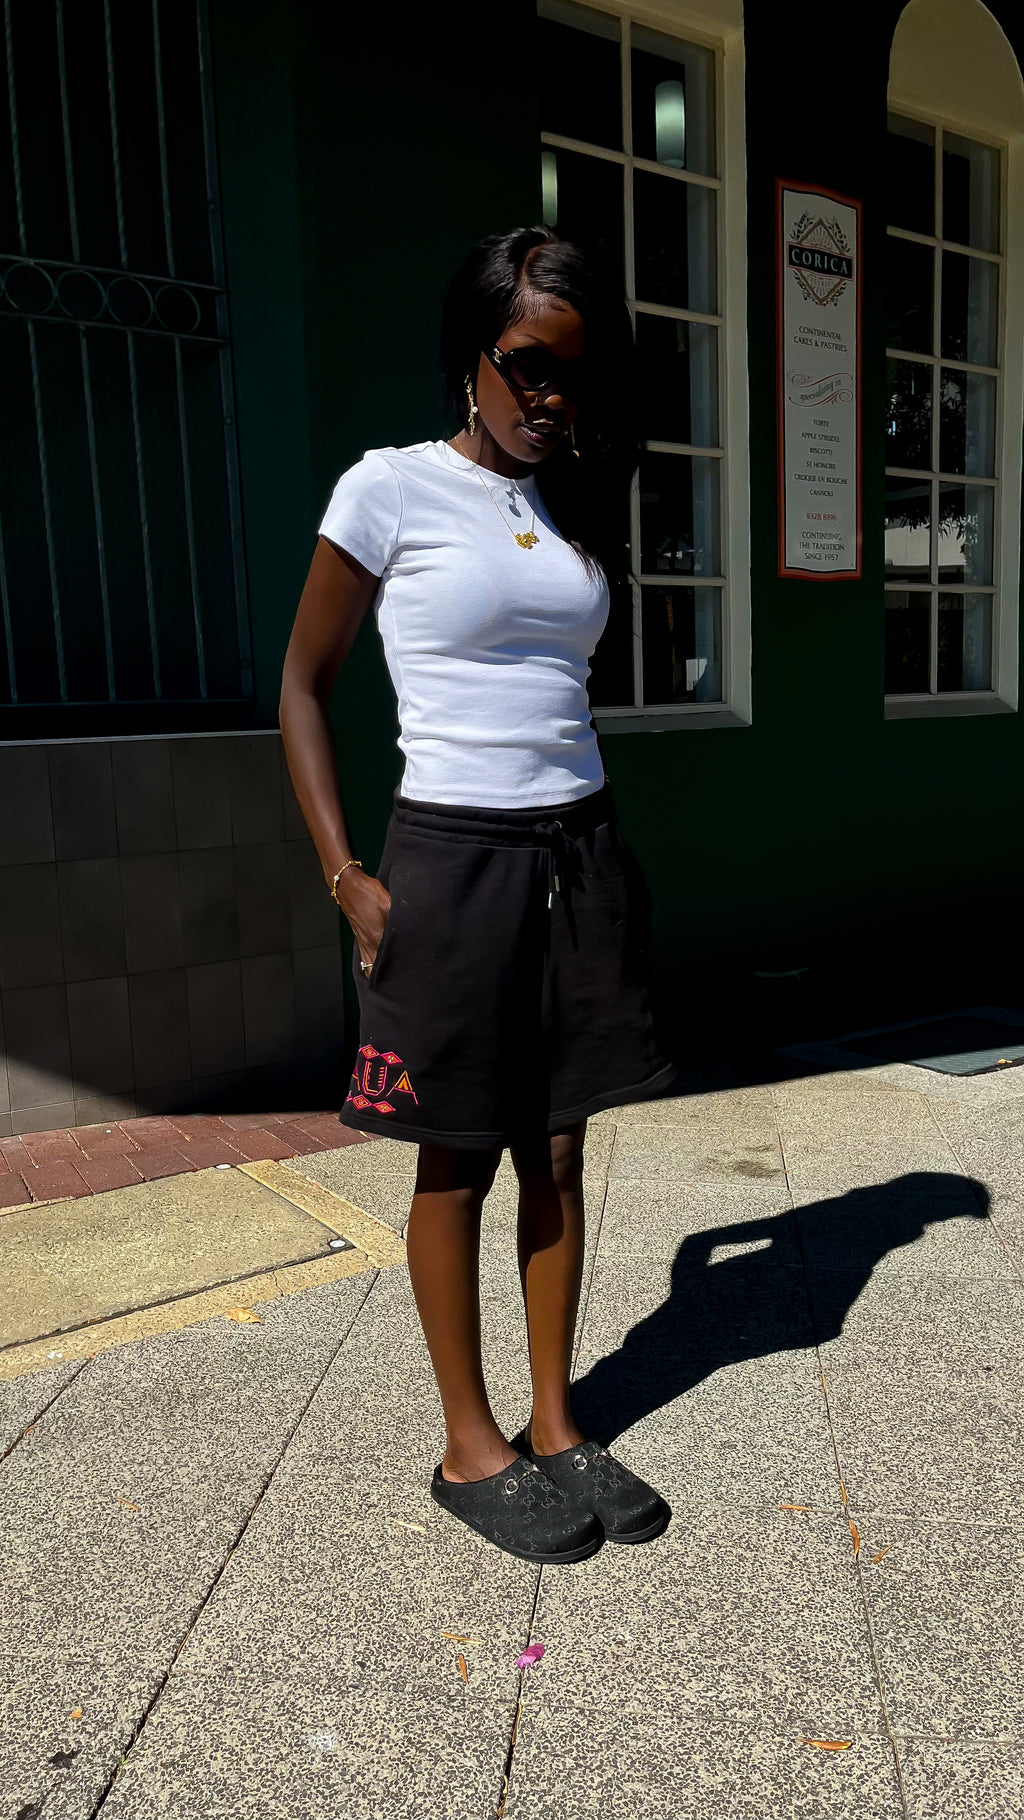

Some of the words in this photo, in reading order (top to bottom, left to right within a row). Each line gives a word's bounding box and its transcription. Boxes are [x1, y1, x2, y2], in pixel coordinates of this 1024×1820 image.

[791, 248, 848, 275] CORICA
[798, 325, 842, 341] CONTINENTAL
[793, 335, 813, 346] CAKES
[814, 340, 819, 348] &
[820, 341, 848, 352] PASTRIES
[801, 432, 817, 440] APPLE
[818, 433, 840, 442] STRUDEL
[809, 447, 833, 455] BISCOTTI
[793, 473, 817, 482] CROQUE
[809, 488, 834, 497] CANNOLI
[801, 531, 842, 541] CONTINUING
[812, 542, 845, 551] TRADITION
[804, 552, 822, 560] SINCE
[824, 553, 839, 561] 1957
